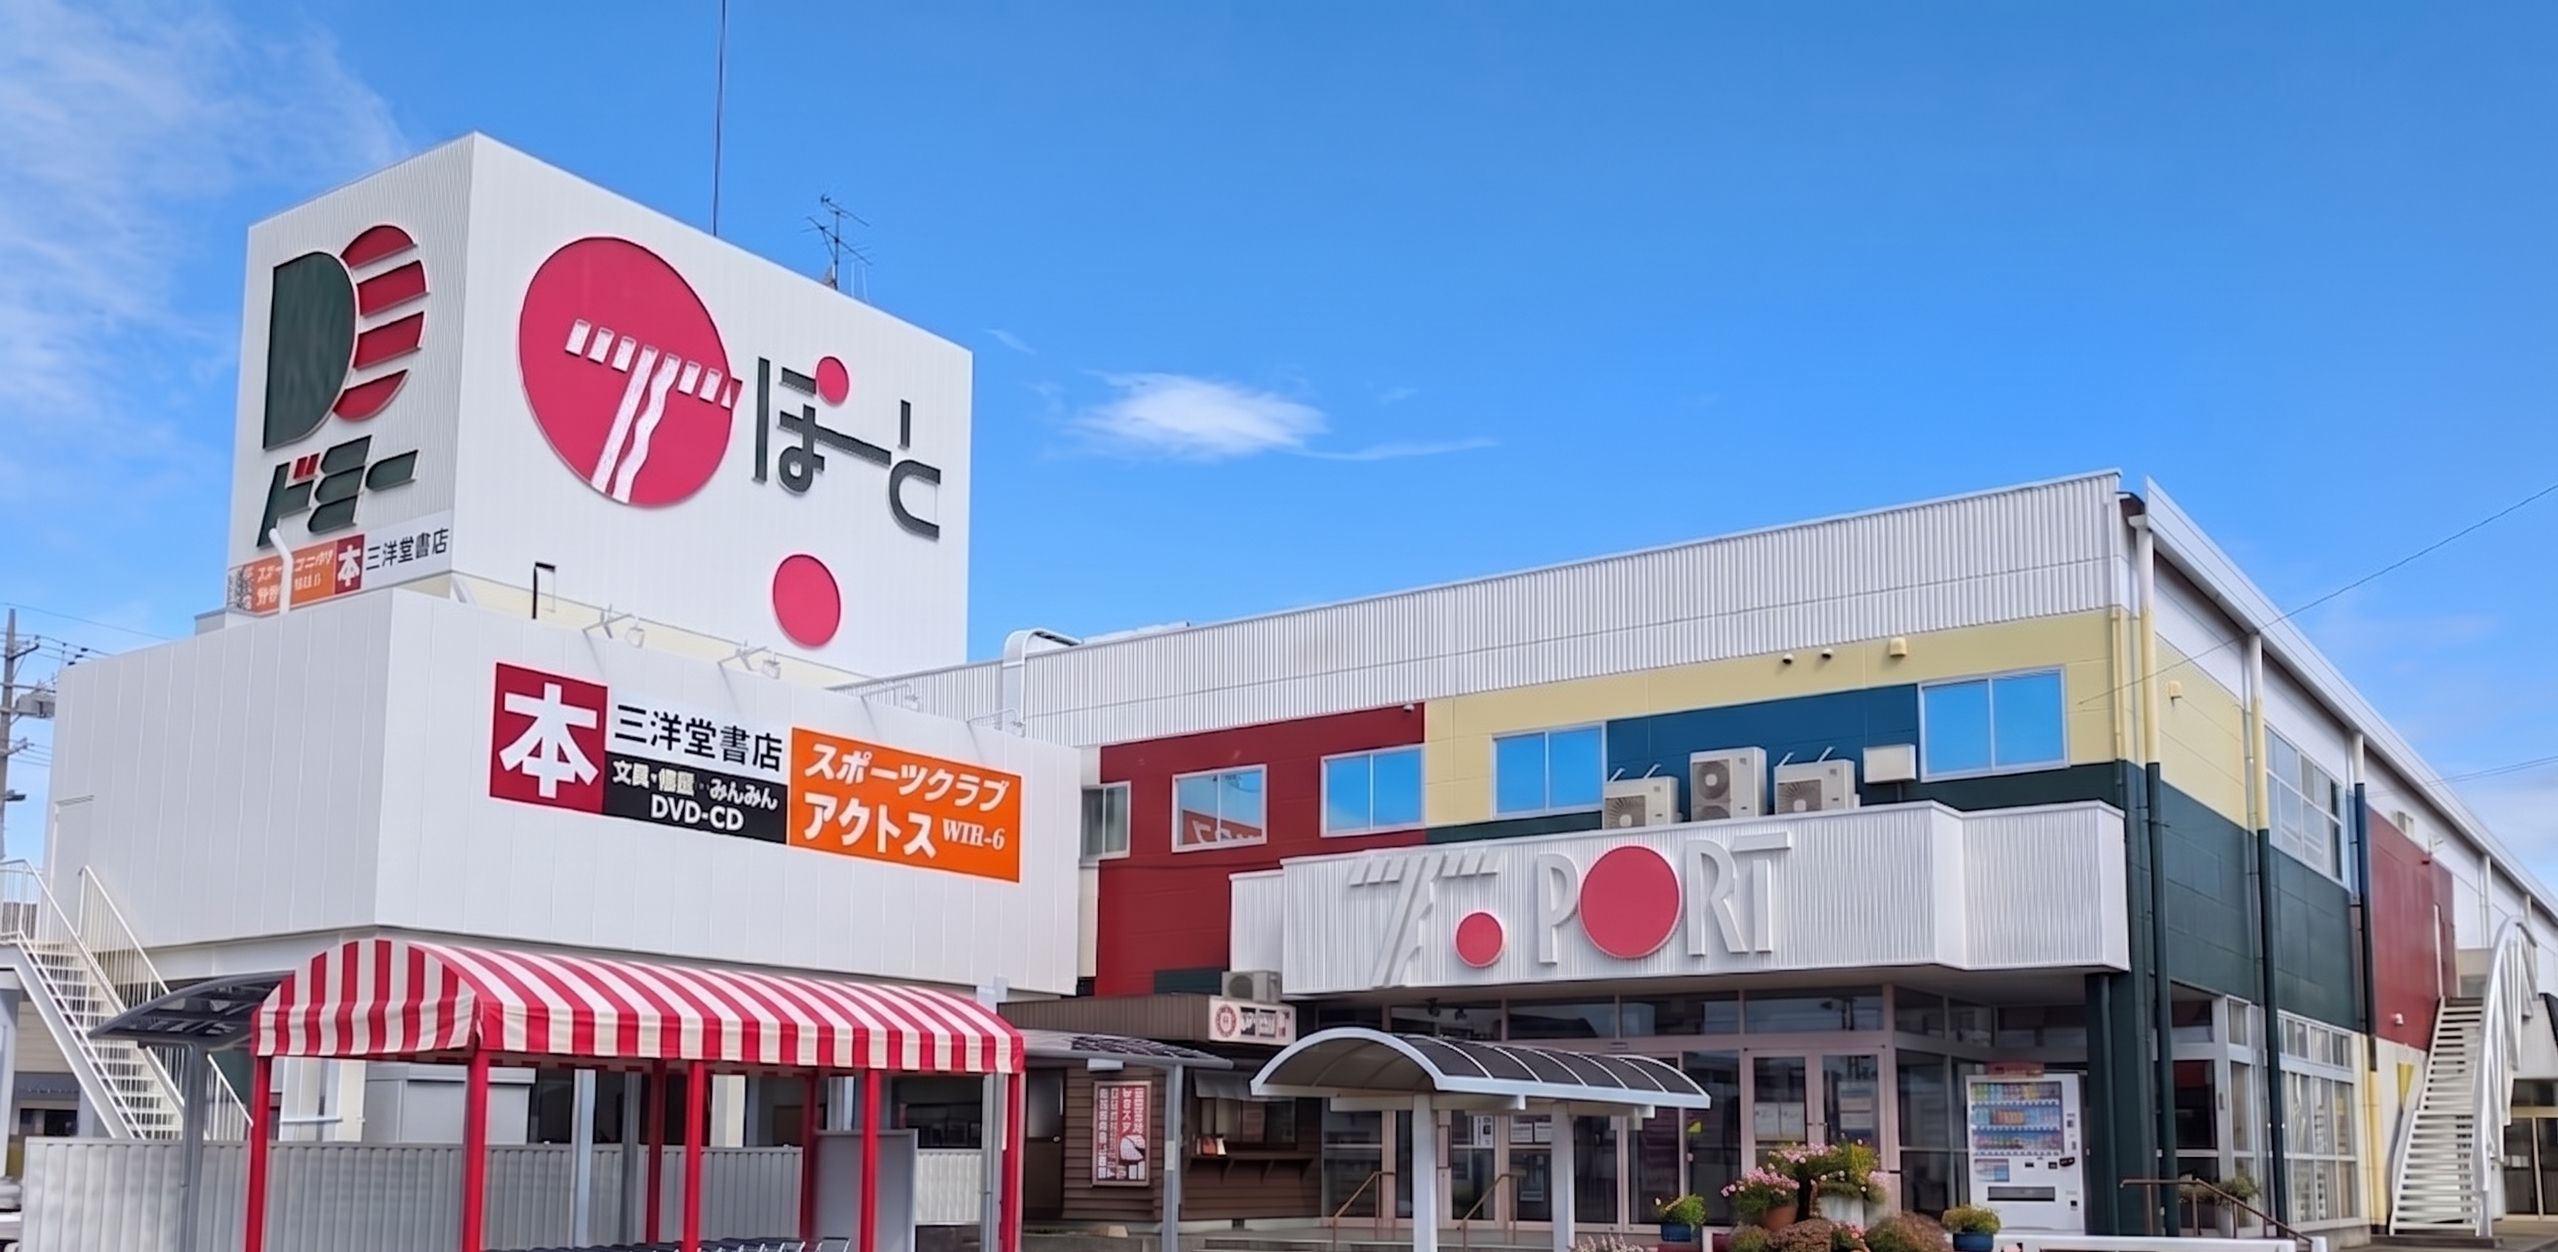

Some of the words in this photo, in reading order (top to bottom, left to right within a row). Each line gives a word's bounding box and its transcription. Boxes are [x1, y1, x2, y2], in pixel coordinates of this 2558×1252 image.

[753, 355, 942, 541] ぽーと
[256, 434, 419, 548] ドミー
[337, 544, 362, 588] 本
[498, 682, 600, 799] 本
[613, 702, 784, 773] 三洋堂書店
[804, 743, 1011, 812] スポーツクラブ
[804, 791, 937, 859] アクトス
